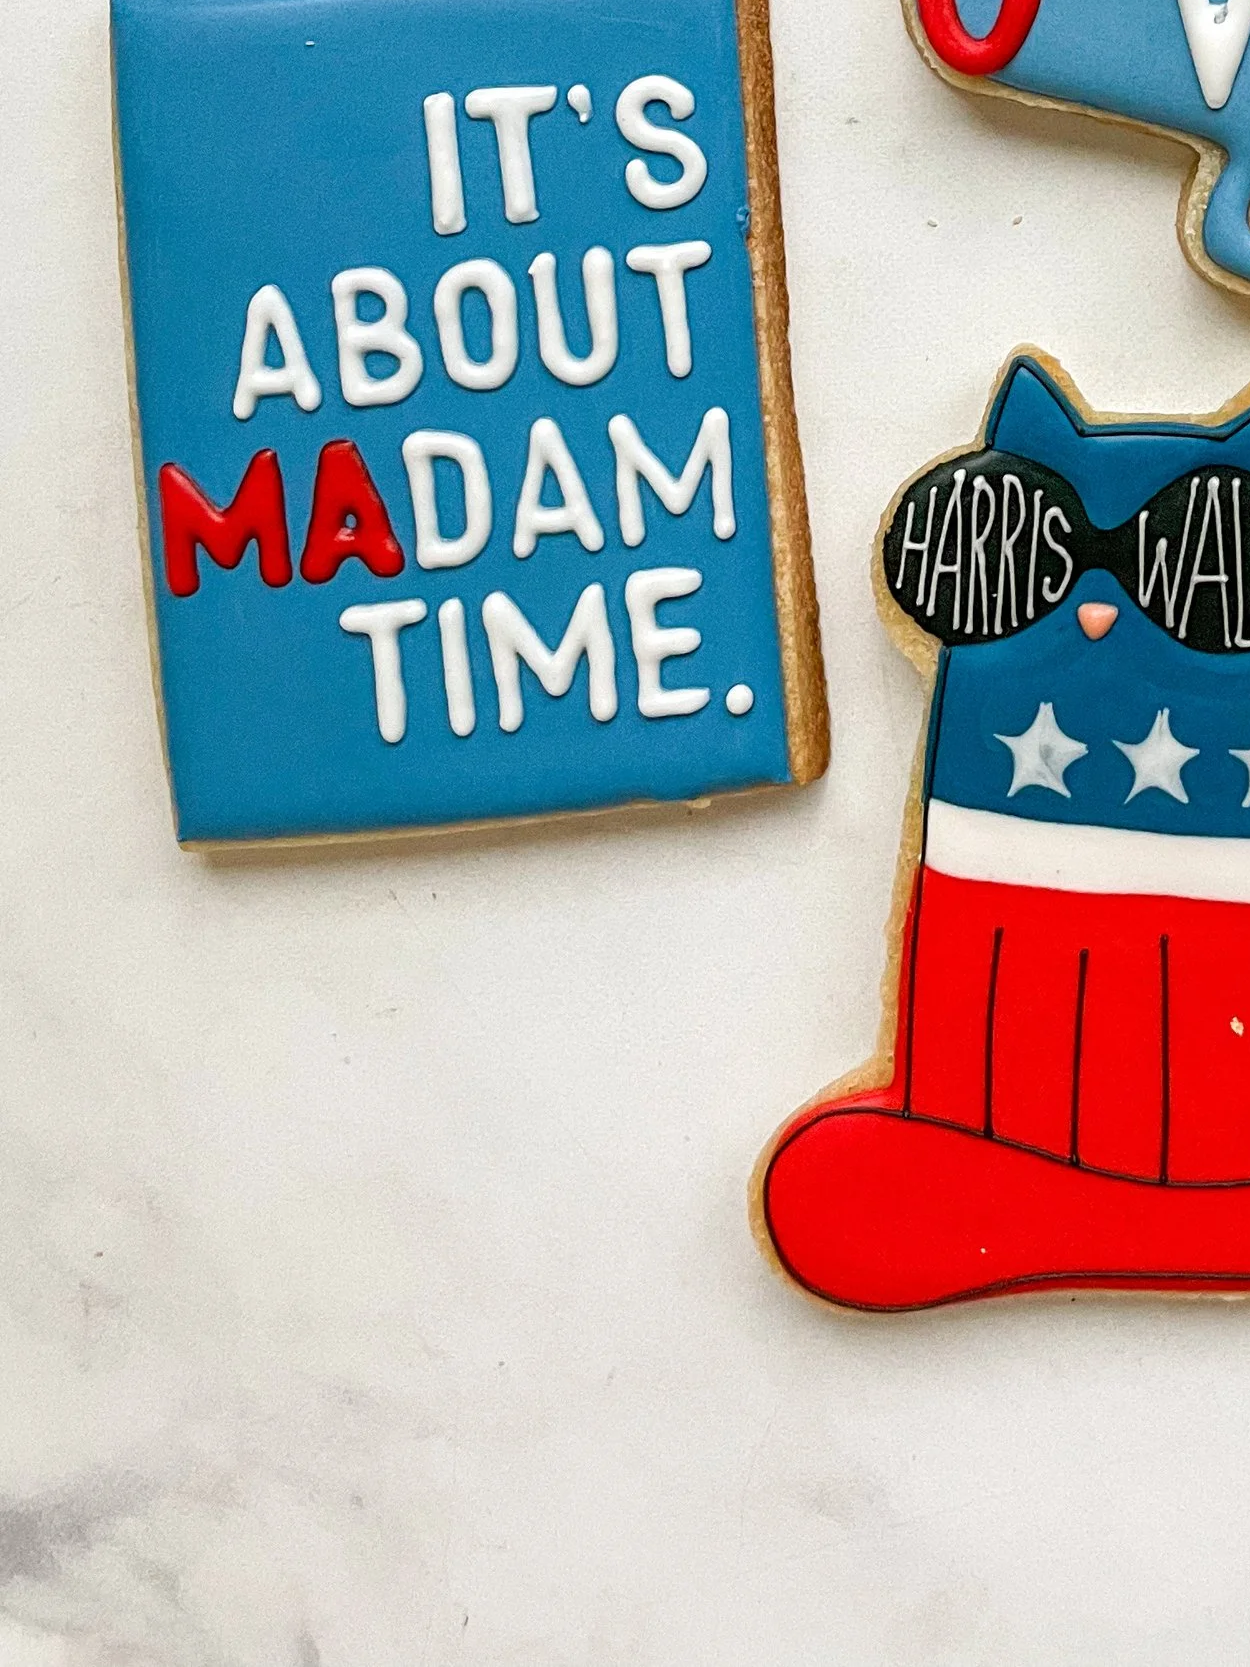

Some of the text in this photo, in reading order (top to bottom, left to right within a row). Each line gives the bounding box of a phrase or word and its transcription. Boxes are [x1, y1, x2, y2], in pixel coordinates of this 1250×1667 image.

[423, 75, 707, 235] IT'S
[233, 240, 712, 420] ABOUT
[159, 406, 736, 597] MADAM
[895, 469, 1073, 635] HARRIS
[339, 567, 754, 743] TIME.
